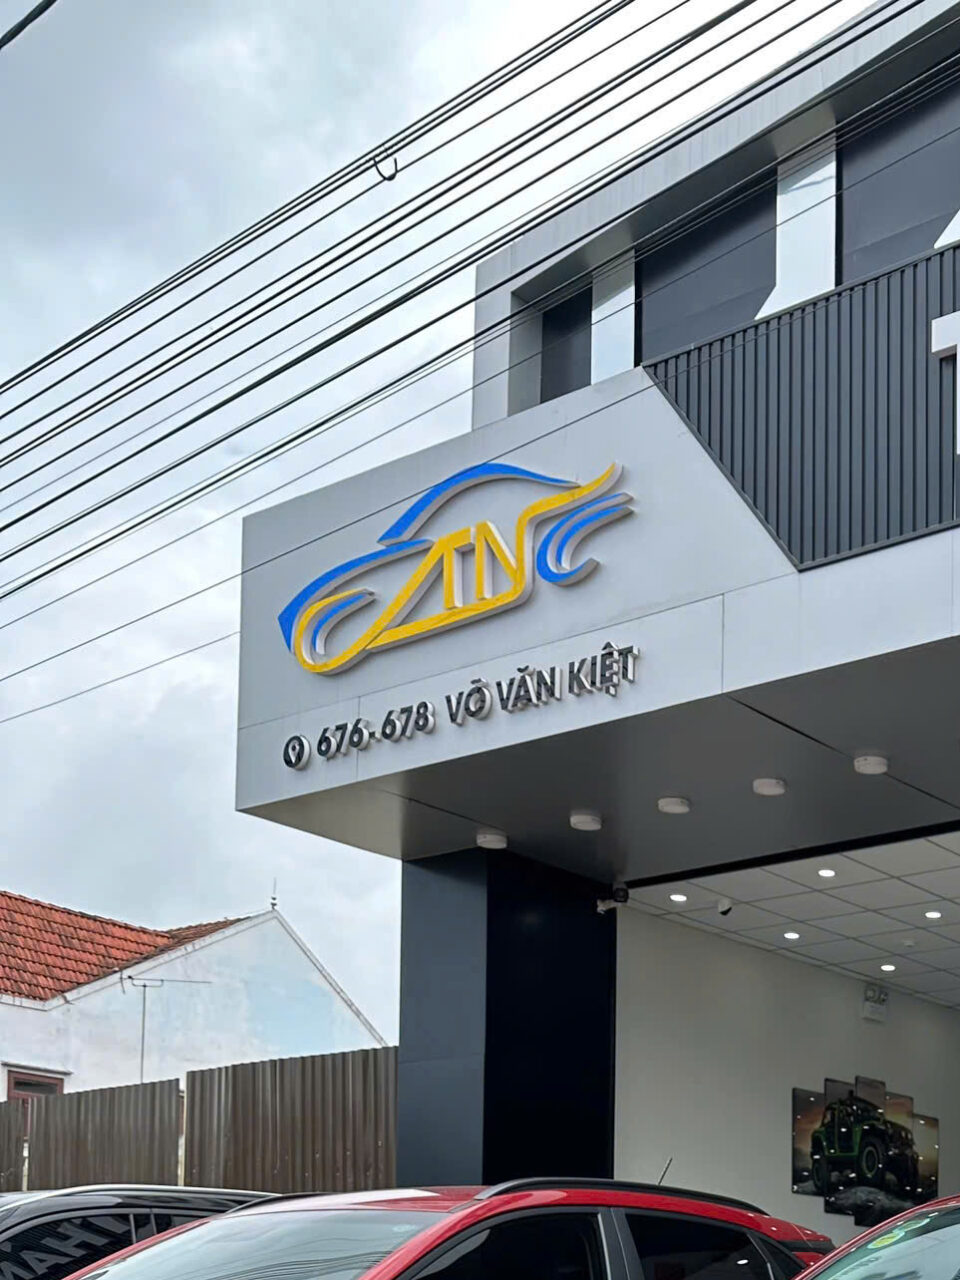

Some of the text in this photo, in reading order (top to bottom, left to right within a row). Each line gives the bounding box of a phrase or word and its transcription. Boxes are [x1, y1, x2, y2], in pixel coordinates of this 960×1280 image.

[445, 677, 494, 726] VÕ
[496, 664, 562, 714] VĂN
[568, 641, 640, 698] KIỆT
